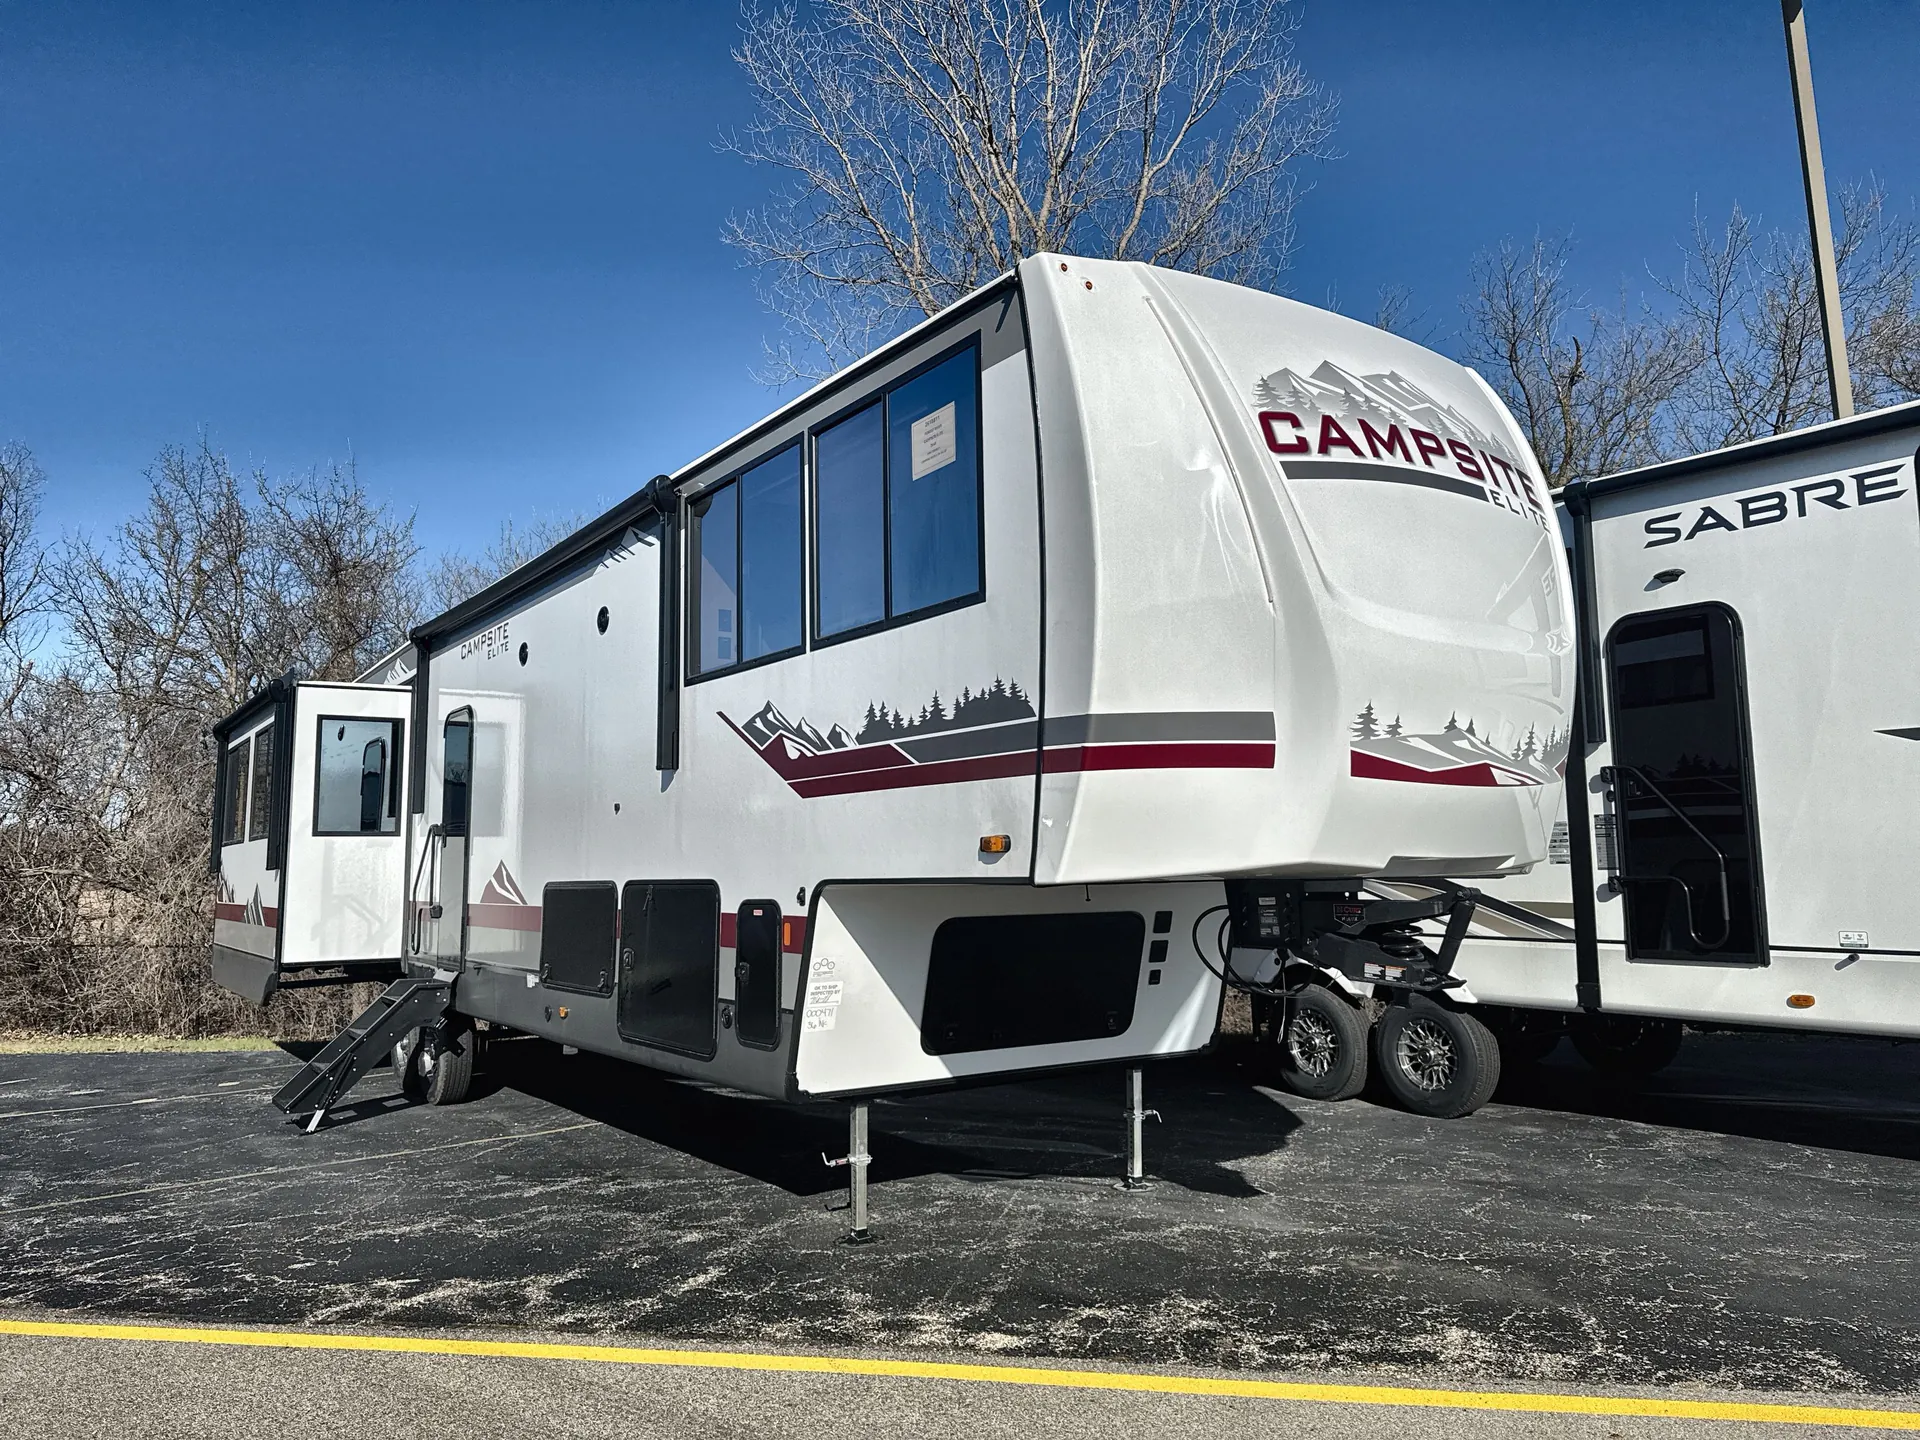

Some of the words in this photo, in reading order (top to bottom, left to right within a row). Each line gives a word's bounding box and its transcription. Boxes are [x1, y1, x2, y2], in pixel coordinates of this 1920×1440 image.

[1258, 411, 1544, 512] CAMPSITE
[1489, 489, 1550, 533] ELITE
[1644, 463, 1909, 549] SABRE
[461, 622, 509, 660] CAMPSITE
[487, 641, 509, 660] ELITE
